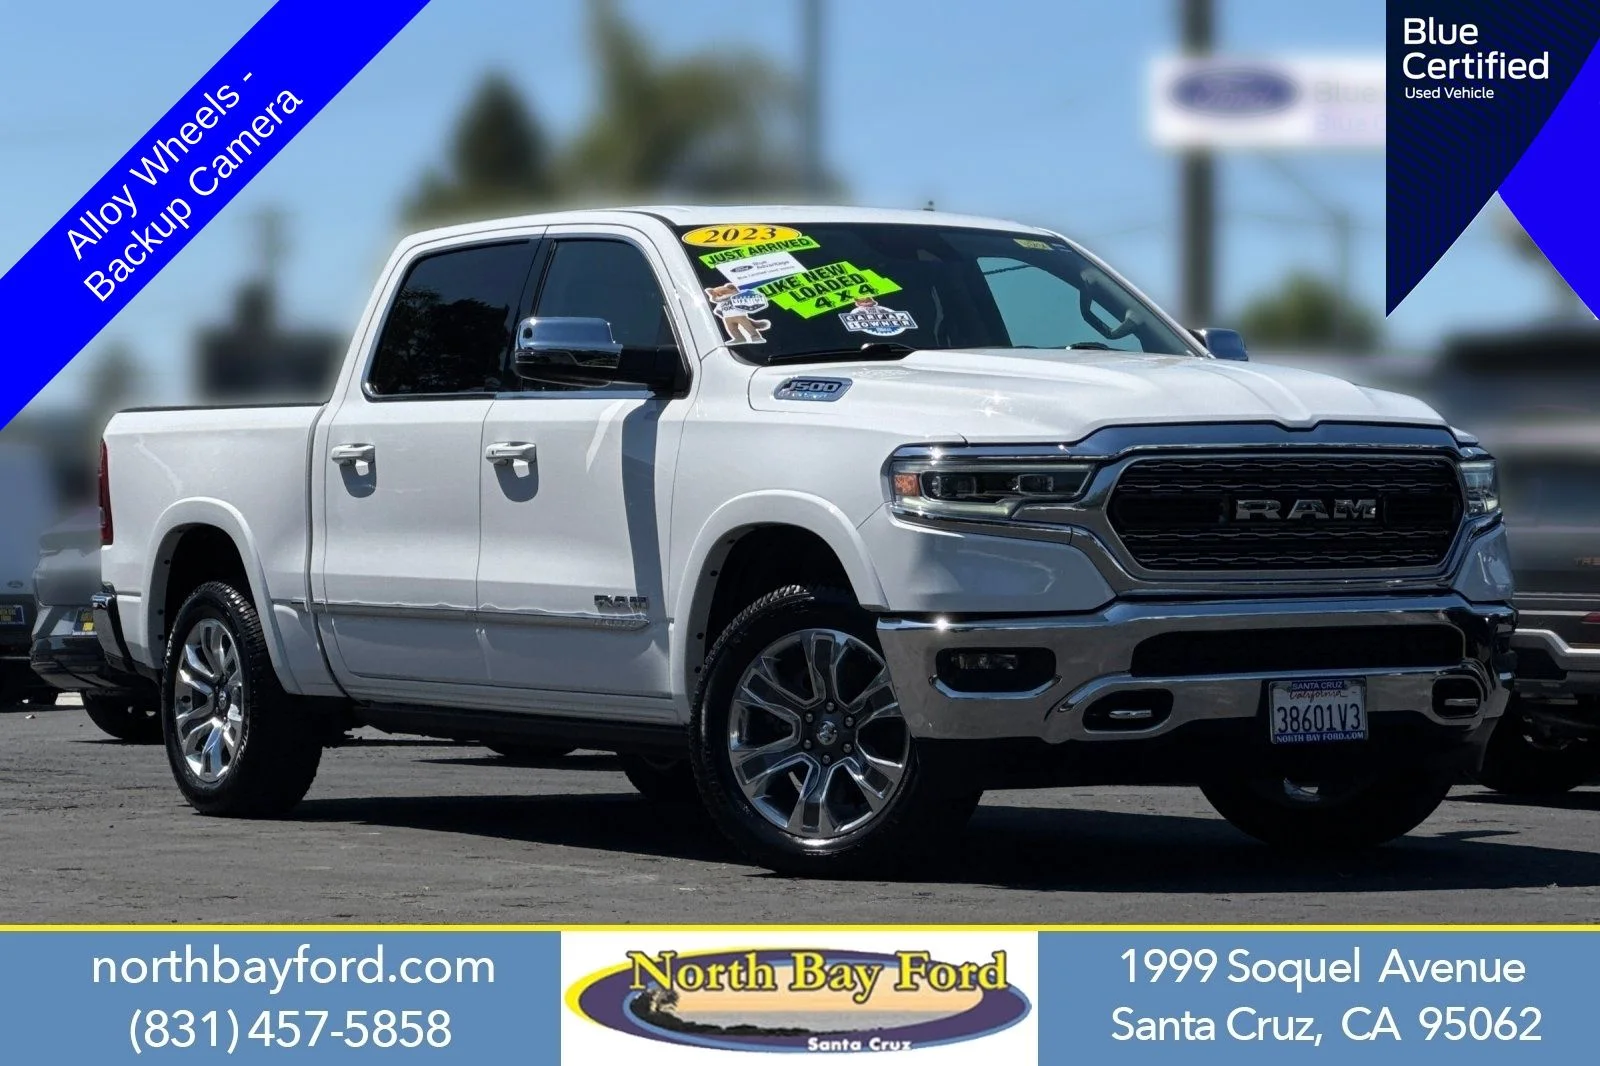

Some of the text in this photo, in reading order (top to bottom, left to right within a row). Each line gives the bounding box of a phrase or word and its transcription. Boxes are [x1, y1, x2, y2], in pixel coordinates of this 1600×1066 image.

[702, 227, 777, 244] 2023
[707, 238, 811, 265] JUST ARRIVED
[757, 276, 800, 298] LIKE
[805, 263, 848, 284] NEW
[789, 273, 868, 302] LOADED
[815, 296, 833, 309] 4
[858, 283, 880, 296] 4
[789, 381, 840, 392] 1500
[1236, 499, 1377, 520] RAM
[594, 595, 649, 611] RAM
[1292, 681, 1343, 690] SANTA CRUZ
[1277, 703, 1360, 733] 38601V3
[1276, 731, 1364, 743] NORTH BAY FORD.COM
